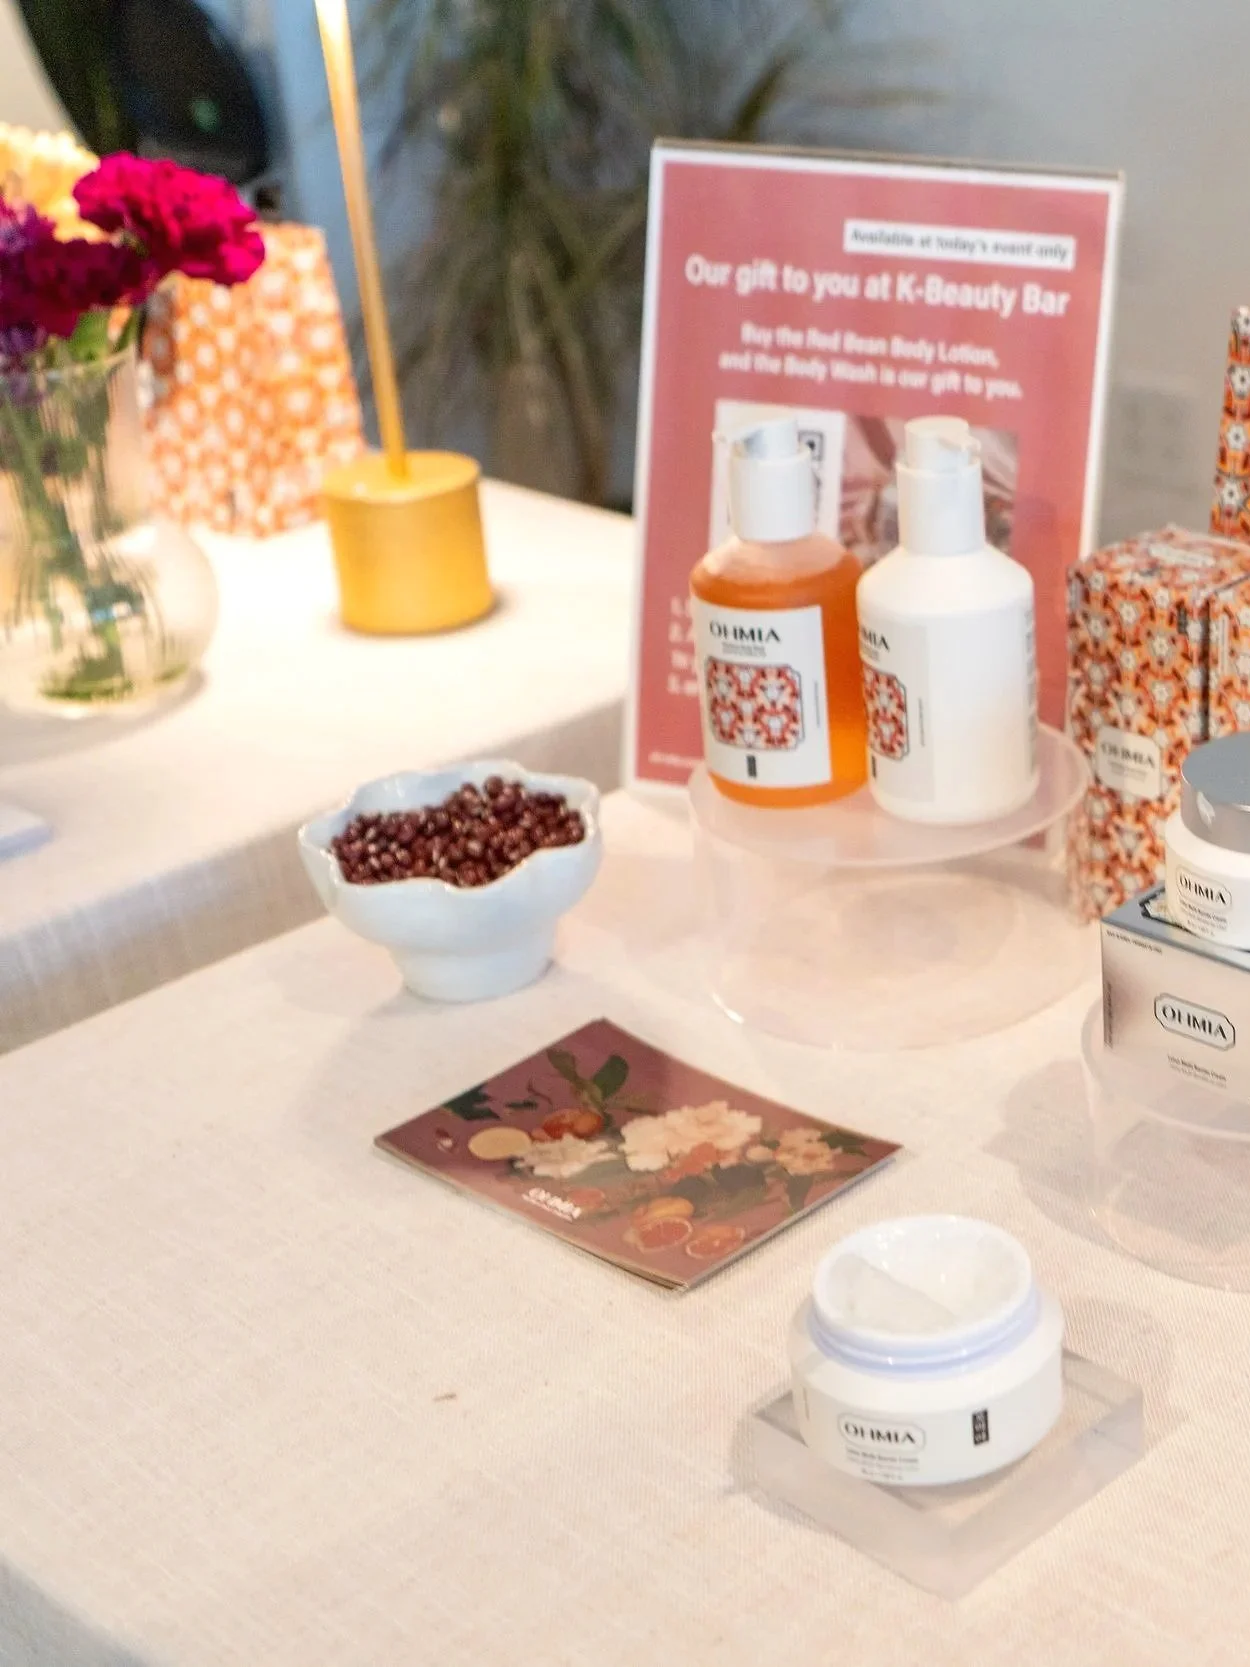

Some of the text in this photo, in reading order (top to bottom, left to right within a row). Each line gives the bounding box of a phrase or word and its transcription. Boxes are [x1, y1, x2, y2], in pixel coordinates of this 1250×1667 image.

[851, 227, 1068, 264] Available at today's event only
[684, 252, 1071, 319] Our gift to you at K-Beauty Bar
[740, 320, 999, 370] Buy the Red Bean Body Lotion,
[718, 352, 751, 373] and
[753, 352, 782, 376] the
[784, 352, 827, 385] Body
[830, 358, 877, 385] Wash
[879, 363, 896, 387] is
[898, 369, 928, 389] our
[930, 369, 961, 397] gift
[963, 373, 984, 395] to
[709, 620, 781, 643] OHMIA
[861, 625, 890, 651] MIA
[1179, 874, 1227, 905] OHMIA
[1162, 1004, 1227, 1040] OHMIA
[844, 1423, 916, 1445] OHMIA
